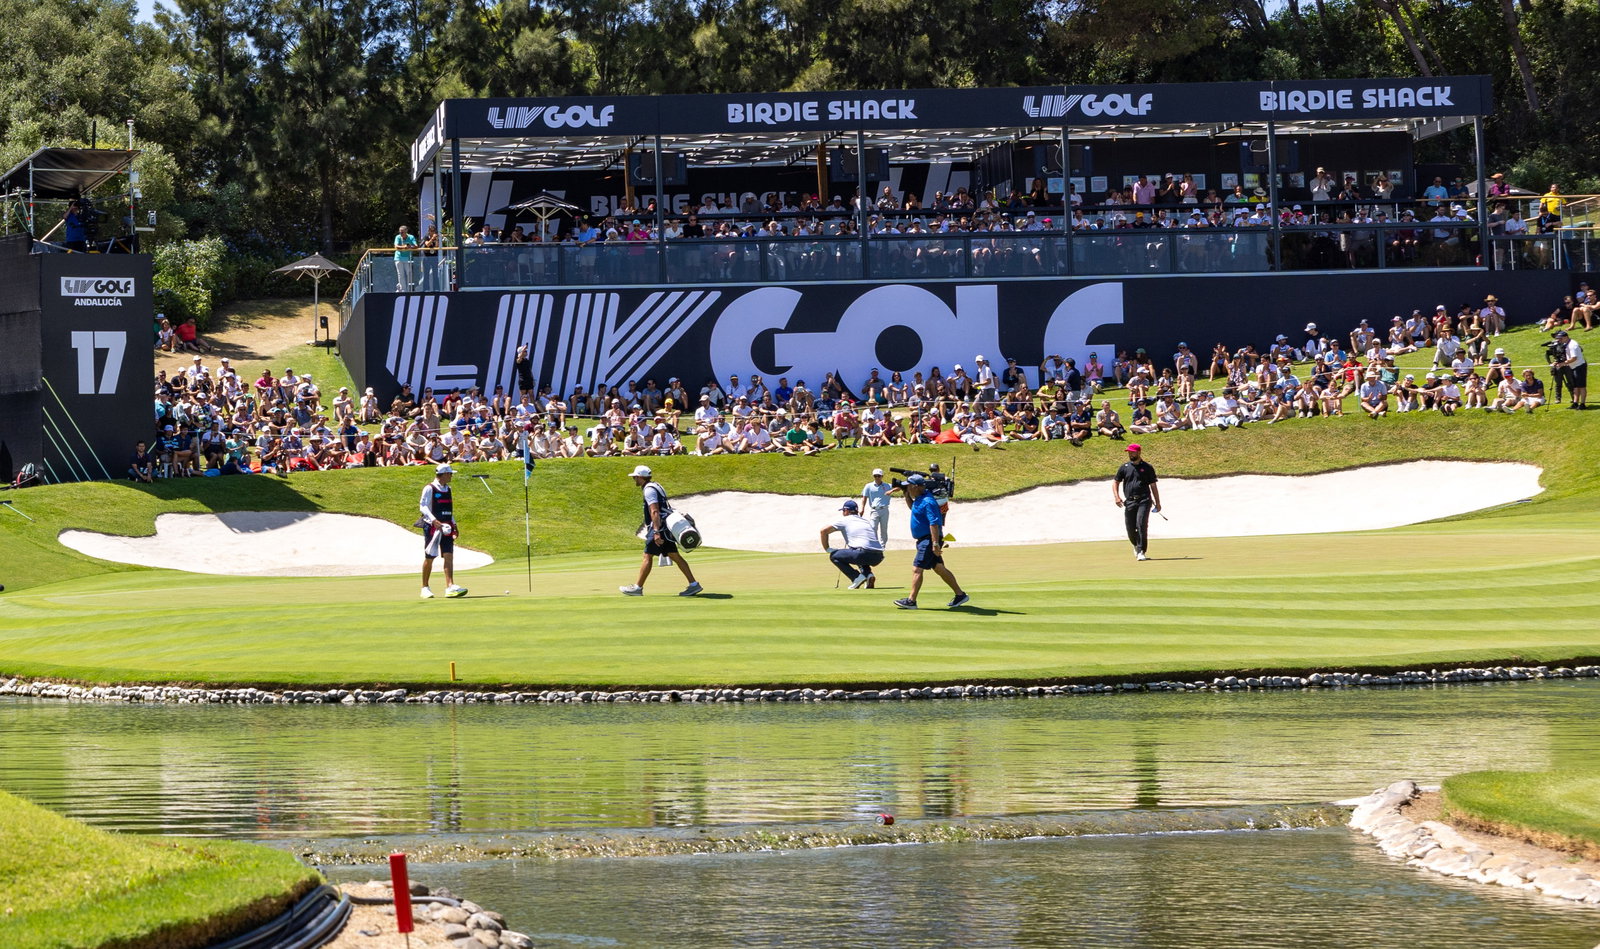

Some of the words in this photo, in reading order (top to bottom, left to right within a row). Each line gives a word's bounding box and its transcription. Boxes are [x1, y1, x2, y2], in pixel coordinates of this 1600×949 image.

[1080, 93, 1153, 117] GOLF
[1259, 89, 1354, 112] BIRDIE
[1362, 86, 1455, 108] SHACK
[543, 105, 615, 128] GOLF
[727, 101, 820, 125] BIRDIE
[828, 99, 918, 121] SHACK
[94, 280, 131, 294] GOLF
[74, 296, 122, 307] ANDALUCÍA
[709, 281, 1124, 400] GOLF
[71, 330, 127, 395] 17
